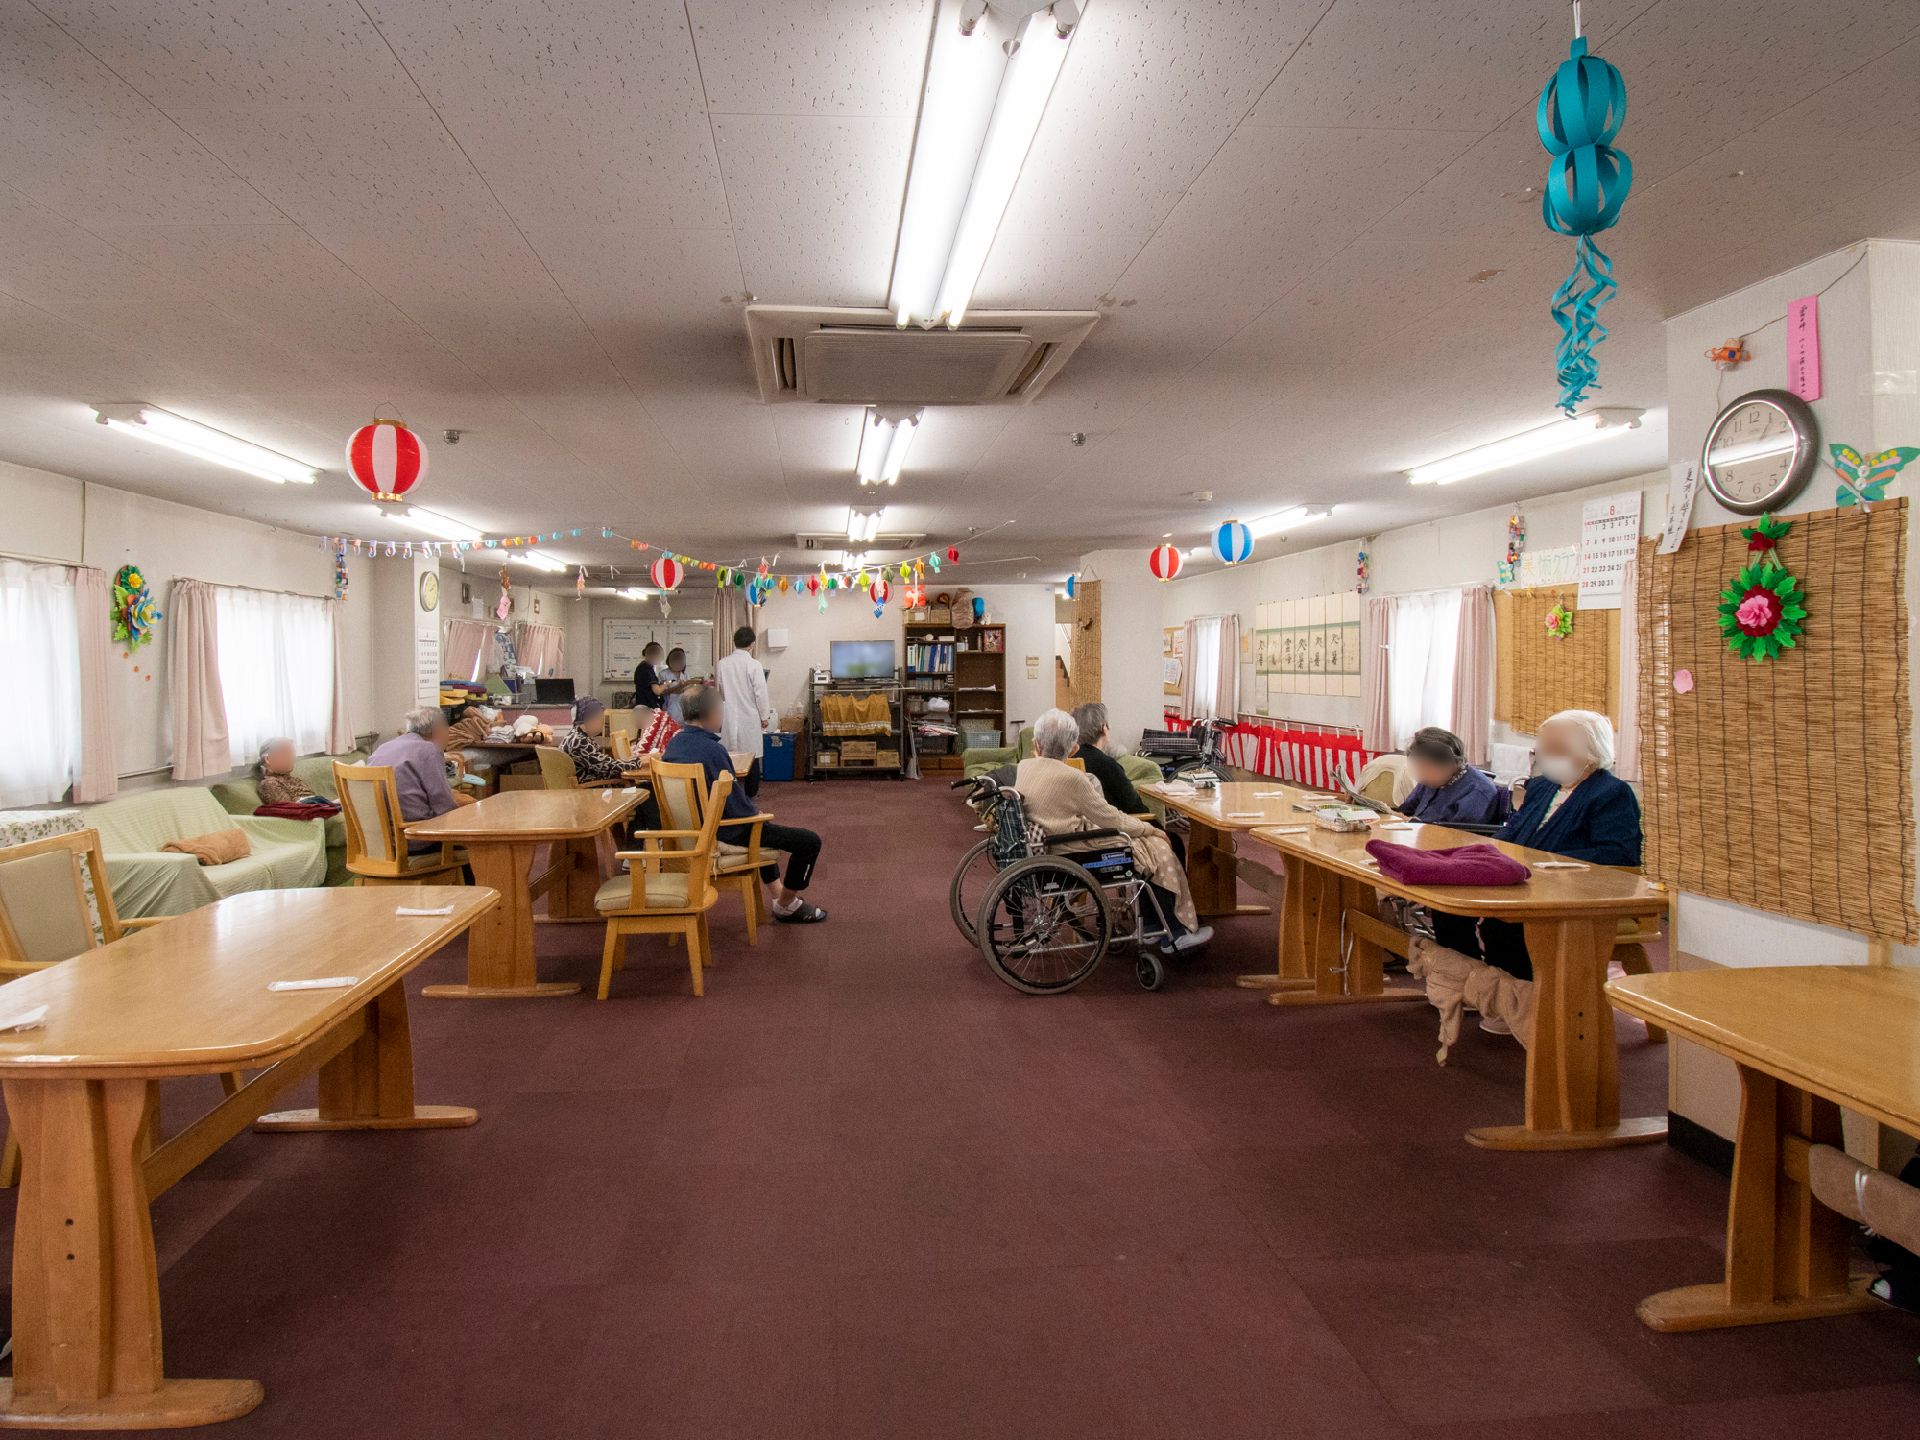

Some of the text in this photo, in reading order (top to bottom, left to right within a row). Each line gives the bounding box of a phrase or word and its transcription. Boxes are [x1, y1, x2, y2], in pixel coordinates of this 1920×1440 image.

[1749, 411, 1760, 424] 12
[1734, 420, 1742, 433] 11
[1722, 437, 1733, 448] 10
[1780, 458, 1788, 469] 4
[1726, 470, 1733, 482] 8
[1769, 473, 1777, 487] 5
[1738, 480, 1744, 493] 7
[1753, 482, 1761, 494] 6
[1609, 505, 1615, 516] 8
